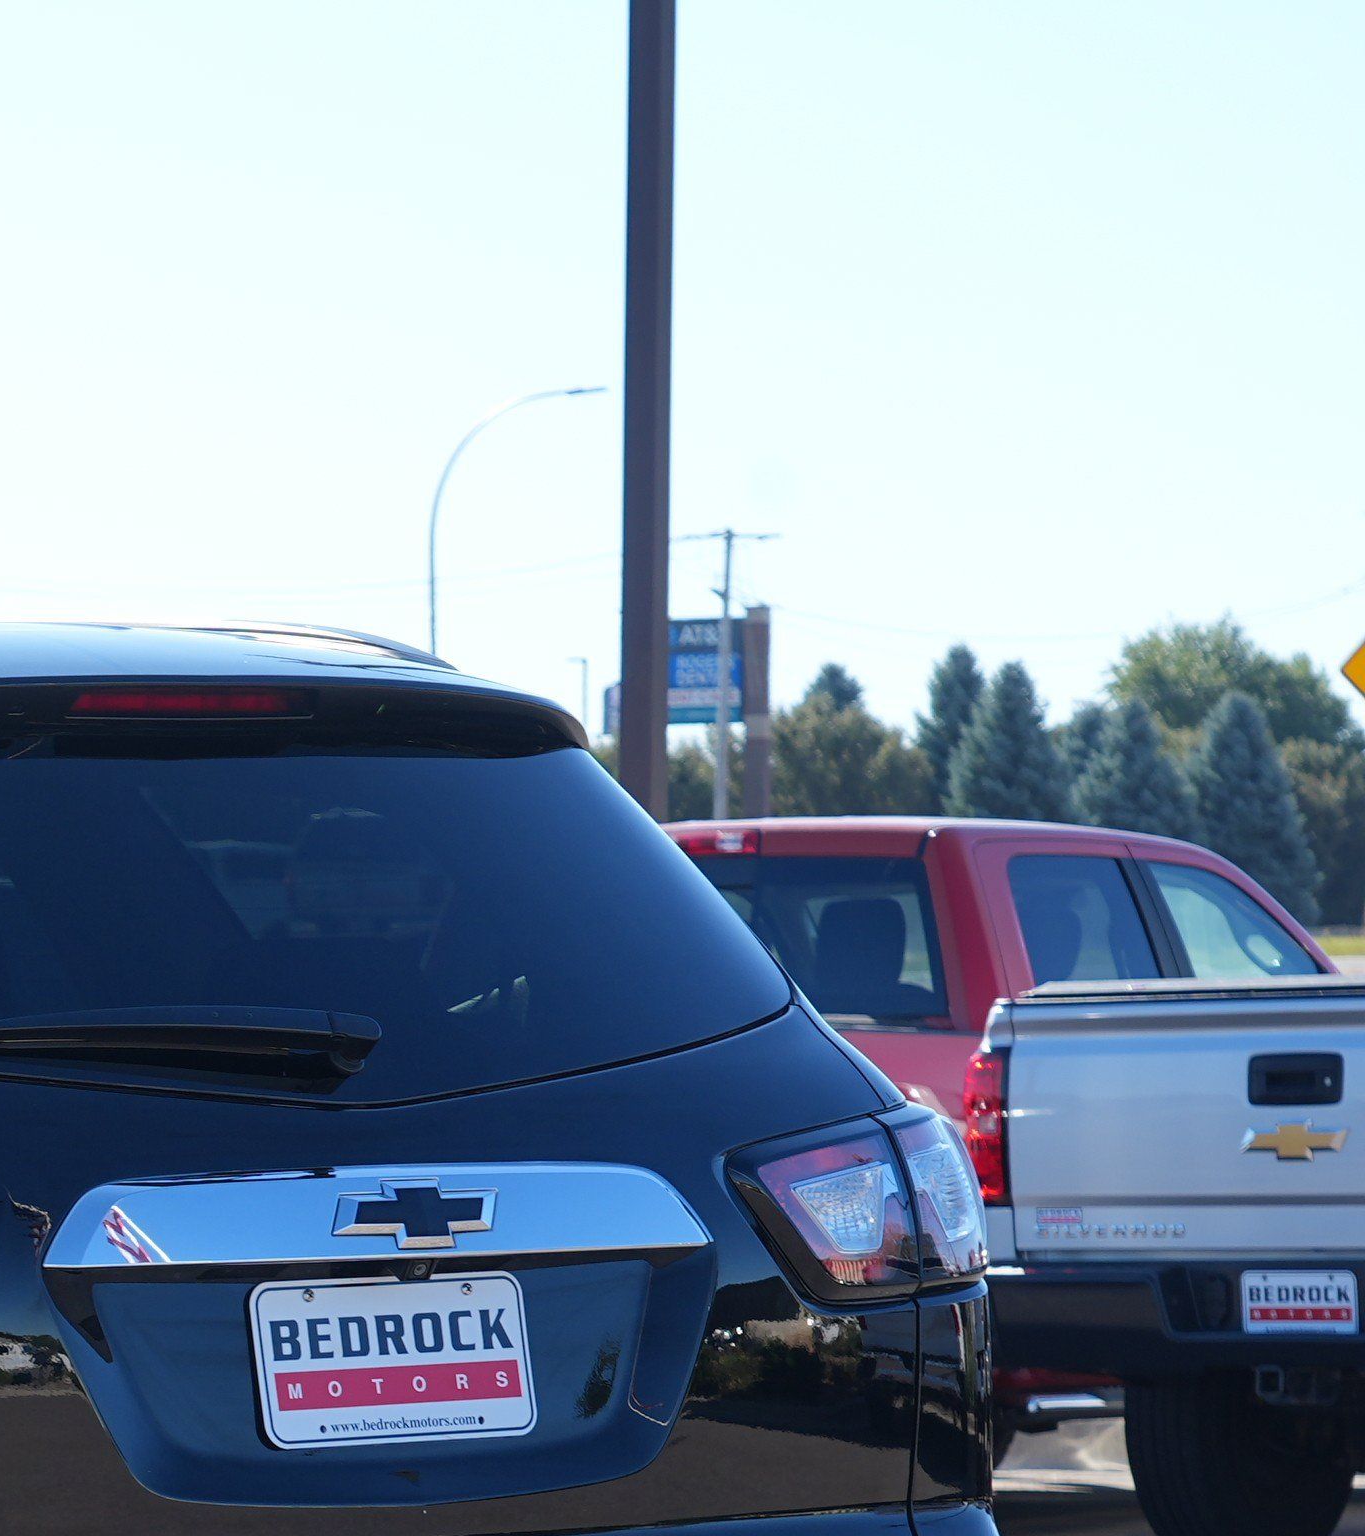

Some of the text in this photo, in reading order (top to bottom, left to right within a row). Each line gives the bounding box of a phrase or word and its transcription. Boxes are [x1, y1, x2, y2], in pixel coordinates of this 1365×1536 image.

[679, 623, 726, 646] AT&
[1249, 1285, 1351, 1302] BEDROCK
[268, 1308, 515, 1362] BEDROCK
[287, 1371, 510, 1400] MOTORS
[330, 1414, 477, 1433] www.bedrockmotors.com
